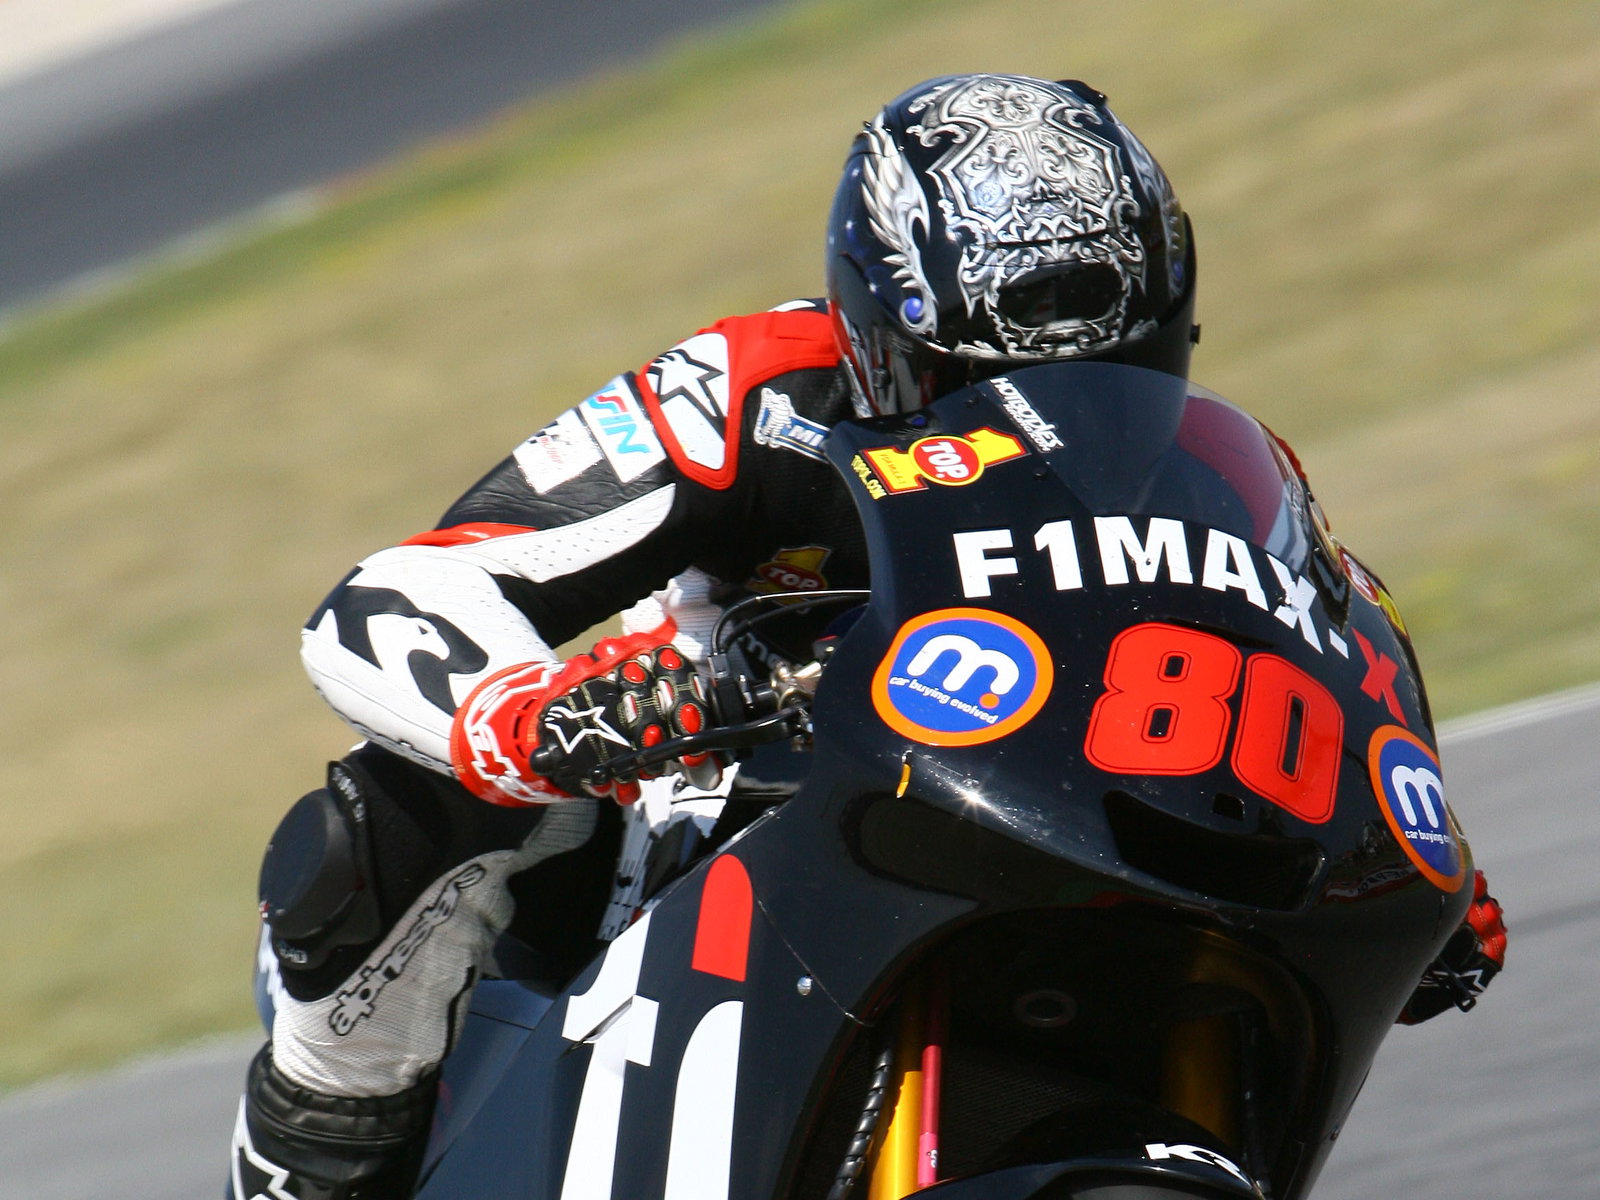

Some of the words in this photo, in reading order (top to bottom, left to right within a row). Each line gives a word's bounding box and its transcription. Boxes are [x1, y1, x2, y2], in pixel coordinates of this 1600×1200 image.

[922, 441, 970, 480] TOP
[768, 566, 819, 589] TOP
[889, 676, 910, 687] car
[909, 679, 951, 704] buying
[950, 698, 999, 724] evolved
[1084, 621, 1344, 824] 80
[1418, 829, 1444, 844] buying
